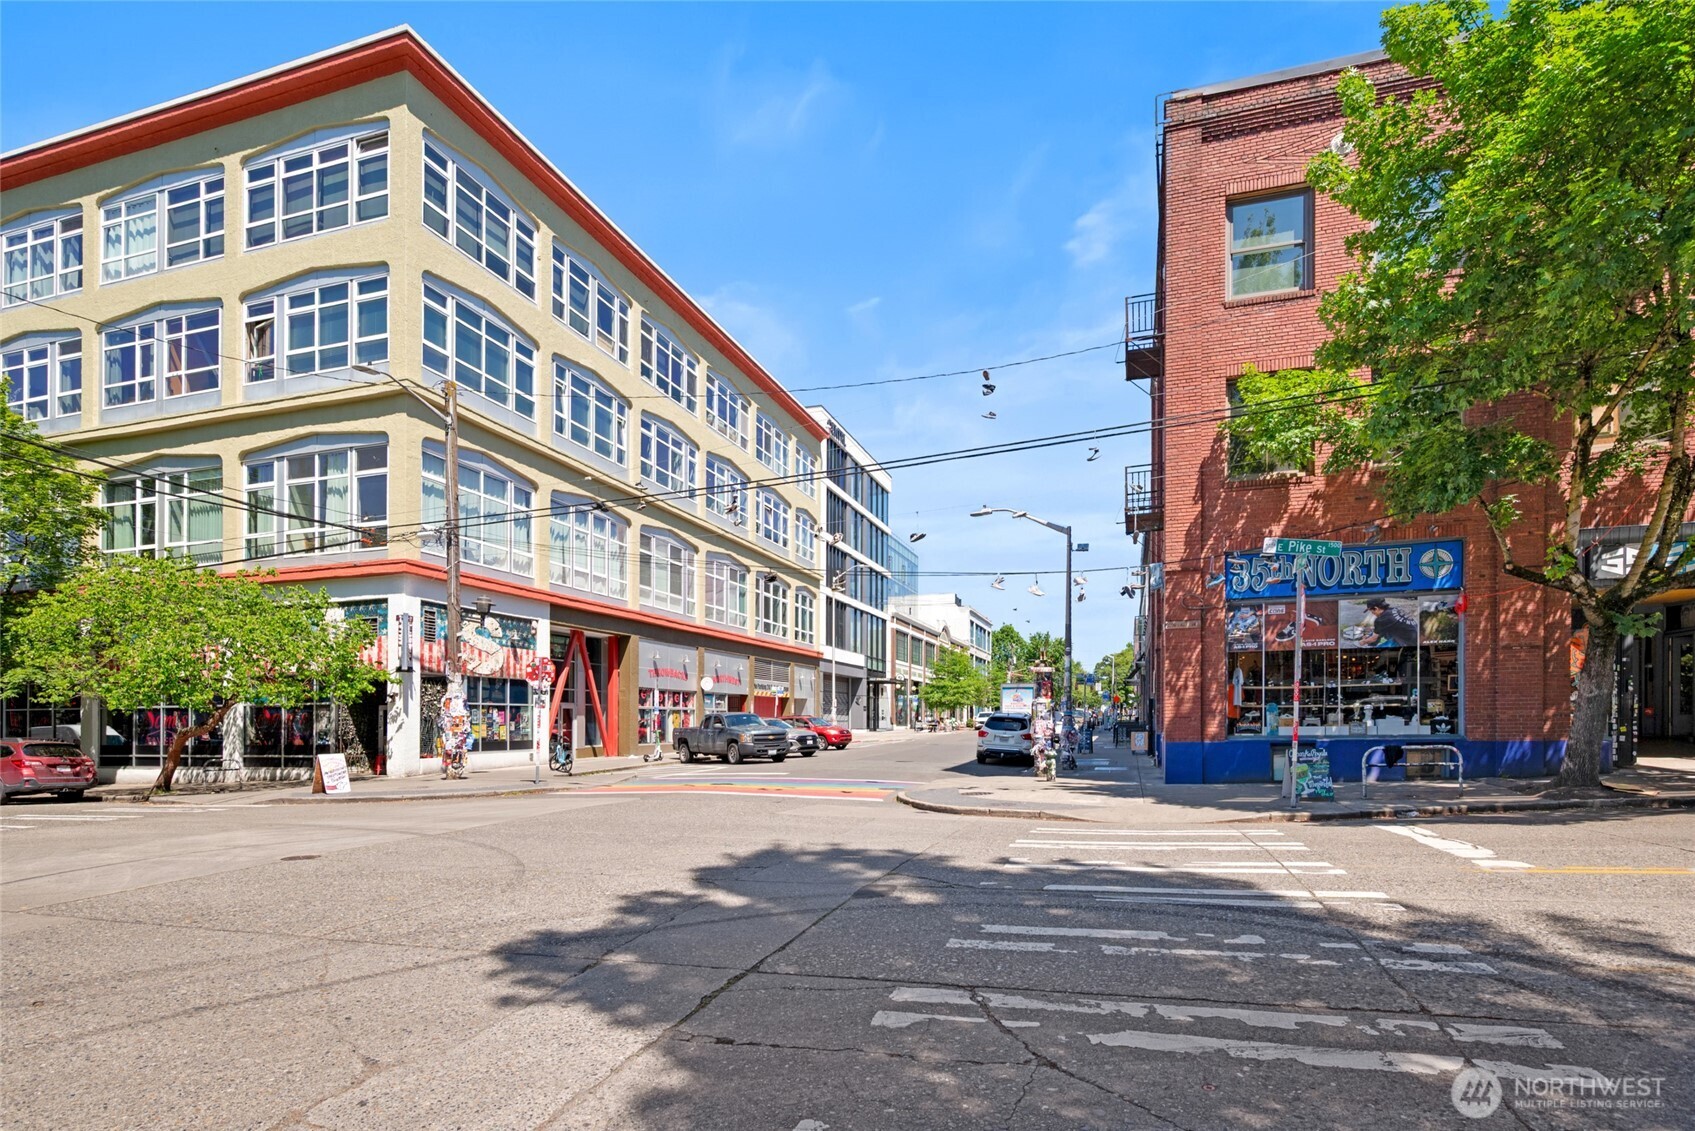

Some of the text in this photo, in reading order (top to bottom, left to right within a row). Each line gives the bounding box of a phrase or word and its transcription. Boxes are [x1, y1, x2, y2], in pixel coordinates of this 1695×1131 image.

[1278, 543, 1283, 551] E
[1288, 540, 1312, 553] Pike
[1316, 545, 1326, 553] St
[1297, 548, 1412, 588] NORTH
